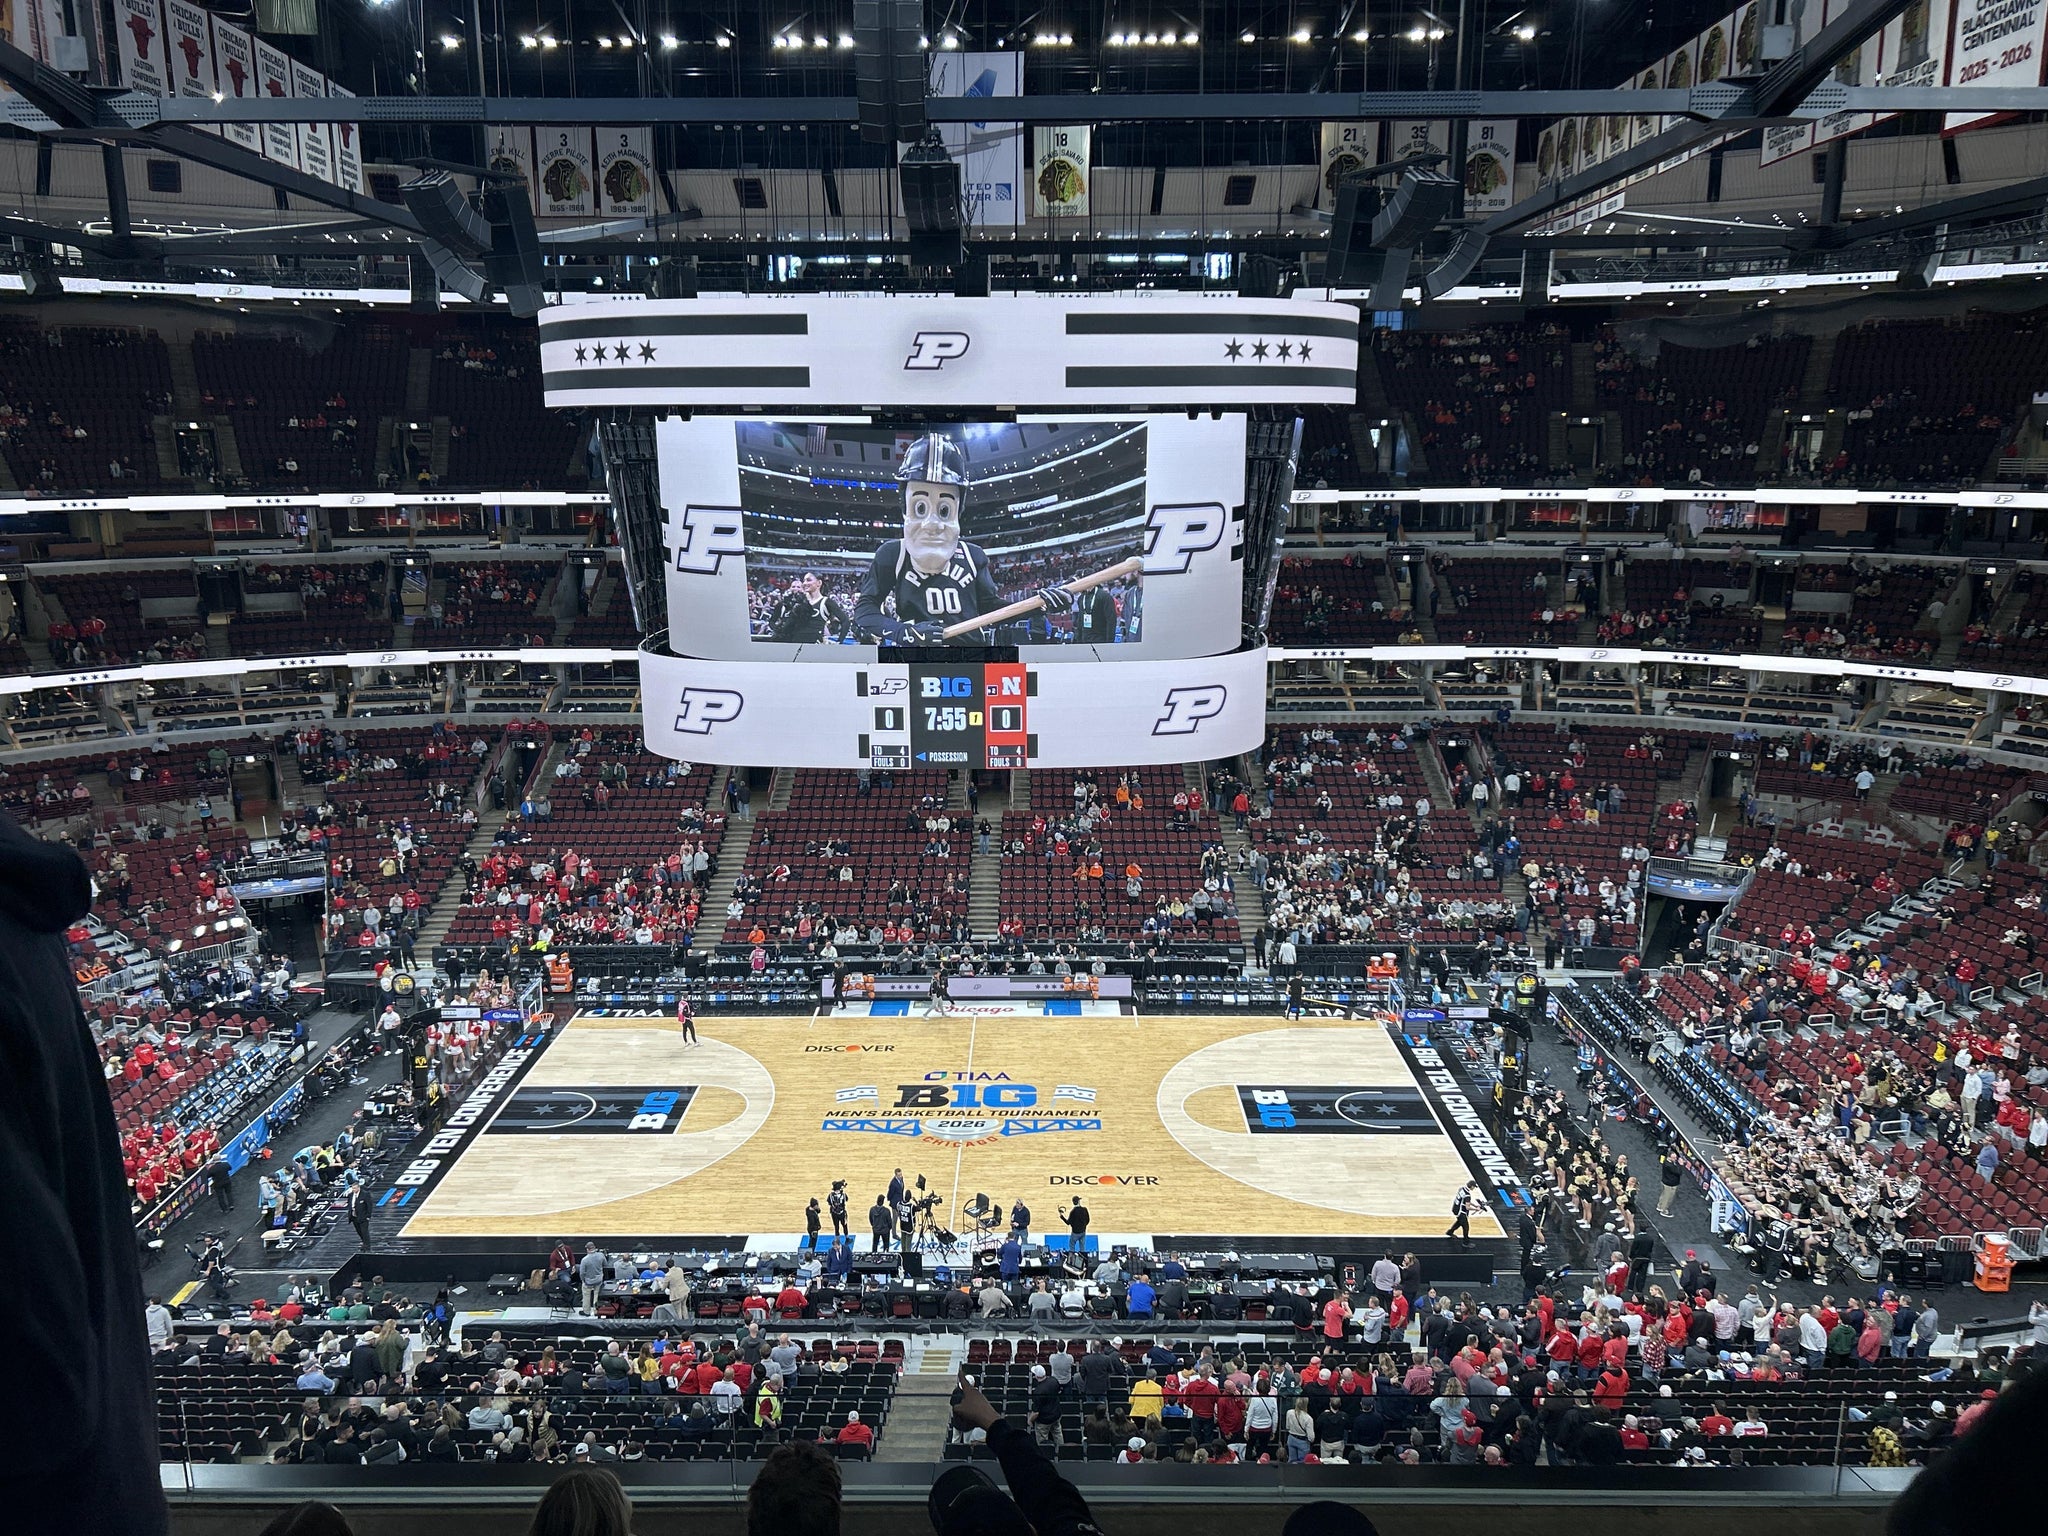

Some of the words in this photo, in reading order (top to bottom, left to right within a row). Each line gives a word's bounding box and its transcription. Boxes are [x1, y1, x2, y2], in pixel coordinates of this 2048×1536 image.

[170, 2, 203, 26] CHICAGO
[218, 27, 247, 50] CHICAGO
[1963, 11, 2035, 51] CENTENNIAL
[1960, 58, 1988, 84] 2025
[2000, 41, 2032, 69] 2026
[560, 133, 568, 147] 3
[1055, 133, 1068, 147] 18
[1343, 128, 1357, 142] 21
[1411, 126, 1427, 139] 35
[1481, 126, 1494, 140] 81
[620, 134, 628, 148] 3
[1466, 142, 1488, 156] ARIAN
[541, 148, 564, 166] PIERRE
[1060, 149, 1085, 166] SAVARD
[904, 332, 970, 370] P
[677, 504, 745, 576] P
[1141, 501, 1226, 576] P
[925, 587, 962, 615] 00
[881, 678, 909, 694] P
[1002, 676, 1021, 696] N
[674, 687, 744, 735] P
[1151, 685, 1227, 736] P
[884, 709, 894, 729] 0
[925, 707, 967, 731] 7:55
[1001, 709, 1011, 729] 0
[874, 746, 882, 755] TO
[900, 746, 905, 755] 4
[929, 752, 968, 762] POSSESSION
[990, 746, 999, 755] TO
[1016, 746, 1021, 755] 4
[873, 757, 894, 767] FOULS
[900, 757, 905, 767] 0
[990, 757, 1010, 767] FOULS
[1016, 757, 1021, 767] 0
[612, 1009, 664, 1017] TIAA
[1309, 1008, 1346, 1017] TIA
[805, 1044, 895, 1053] DISCOVER
[1411, 1048, 1445, 1067] BIG
[952, 1072, 1012, 1081] TIAA
[1425, 1068, 1462, 1092] TEN
[394, 1160, 442, 1185] BIG
[423, 1128, 467, 1154] TEN
[447, 1048, 534, 1126] CONFERENCE
[937, 1120, 986, 1128] 2026
[923, 1135, 998, 1148] CHICAGO
[1440, 1095, 1522, 1186] CONFERENCE
[1050, 1175, 1160, 1185] DISCOVER
[305, 1293, 319, 1306] 55
